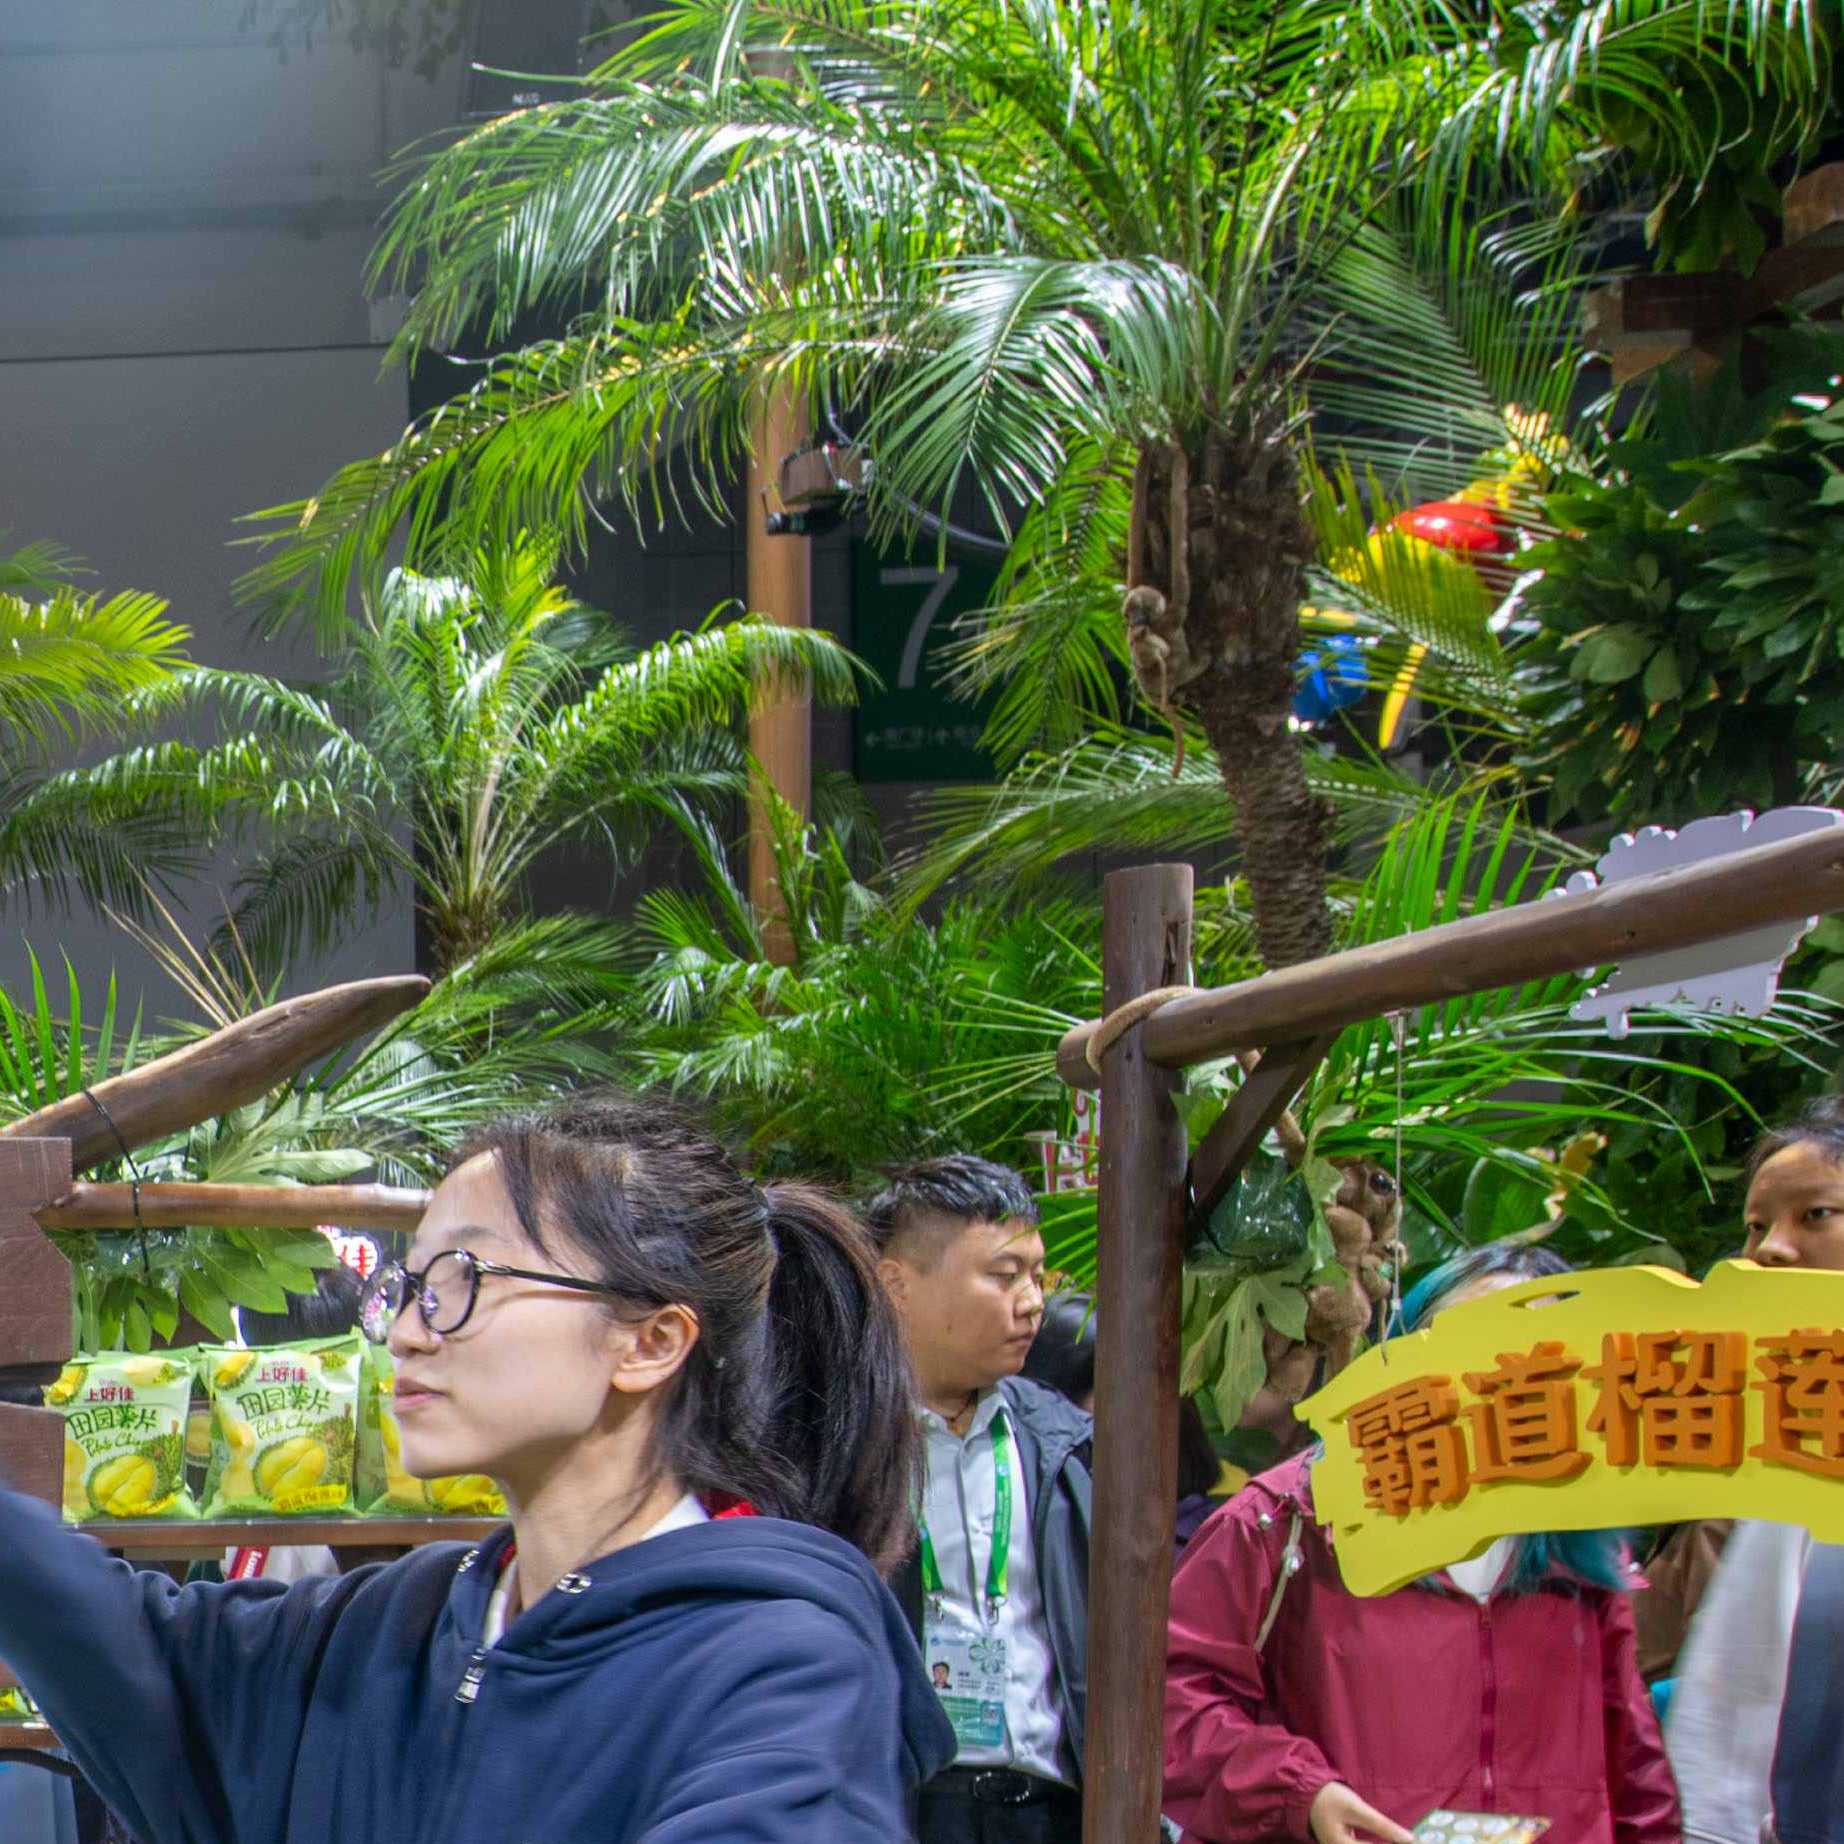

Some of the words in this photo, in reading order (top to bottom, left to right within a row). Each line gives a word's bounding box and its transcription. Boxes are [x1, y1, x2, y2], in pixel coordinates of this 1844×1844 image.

[881, 567, 958, 689] 7
[257, 1367, 308, 1383] 上好佳
[86, 1387, 134, 1401] 上好佳
[237, 1386, 332, 1420] 田园薯片
[67, 1403, 159, 1439] 田园薯片
